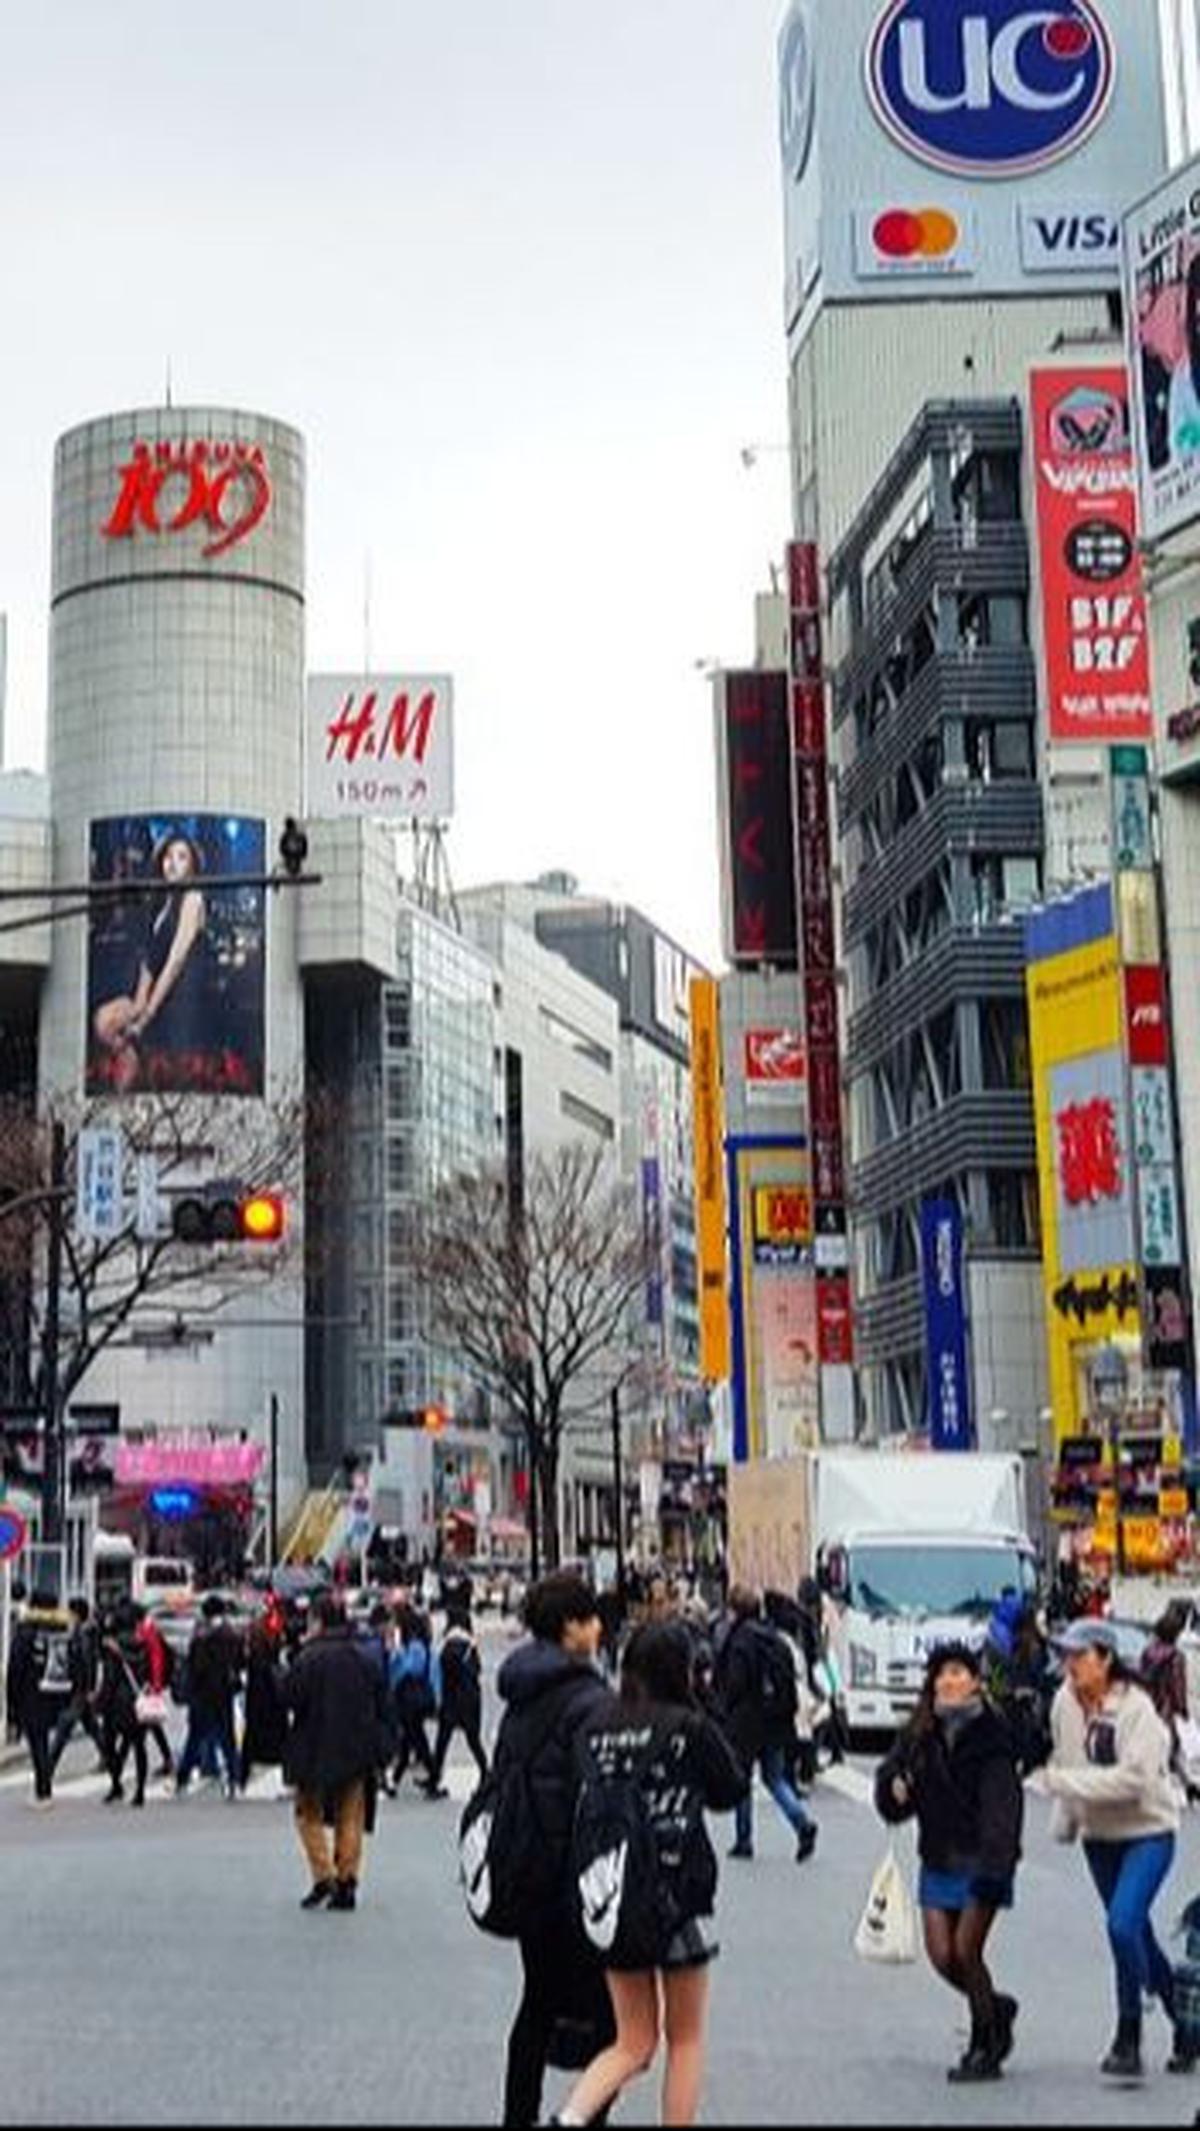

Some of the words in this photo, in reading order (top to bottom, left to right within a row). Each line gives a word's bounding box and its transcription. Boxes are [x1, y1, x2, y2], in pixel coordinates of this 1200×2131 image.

[101, 458, 272, 557] 109
[1071, 634, 1139, 673] B2F
[325, 692, 436, 763] H&M
